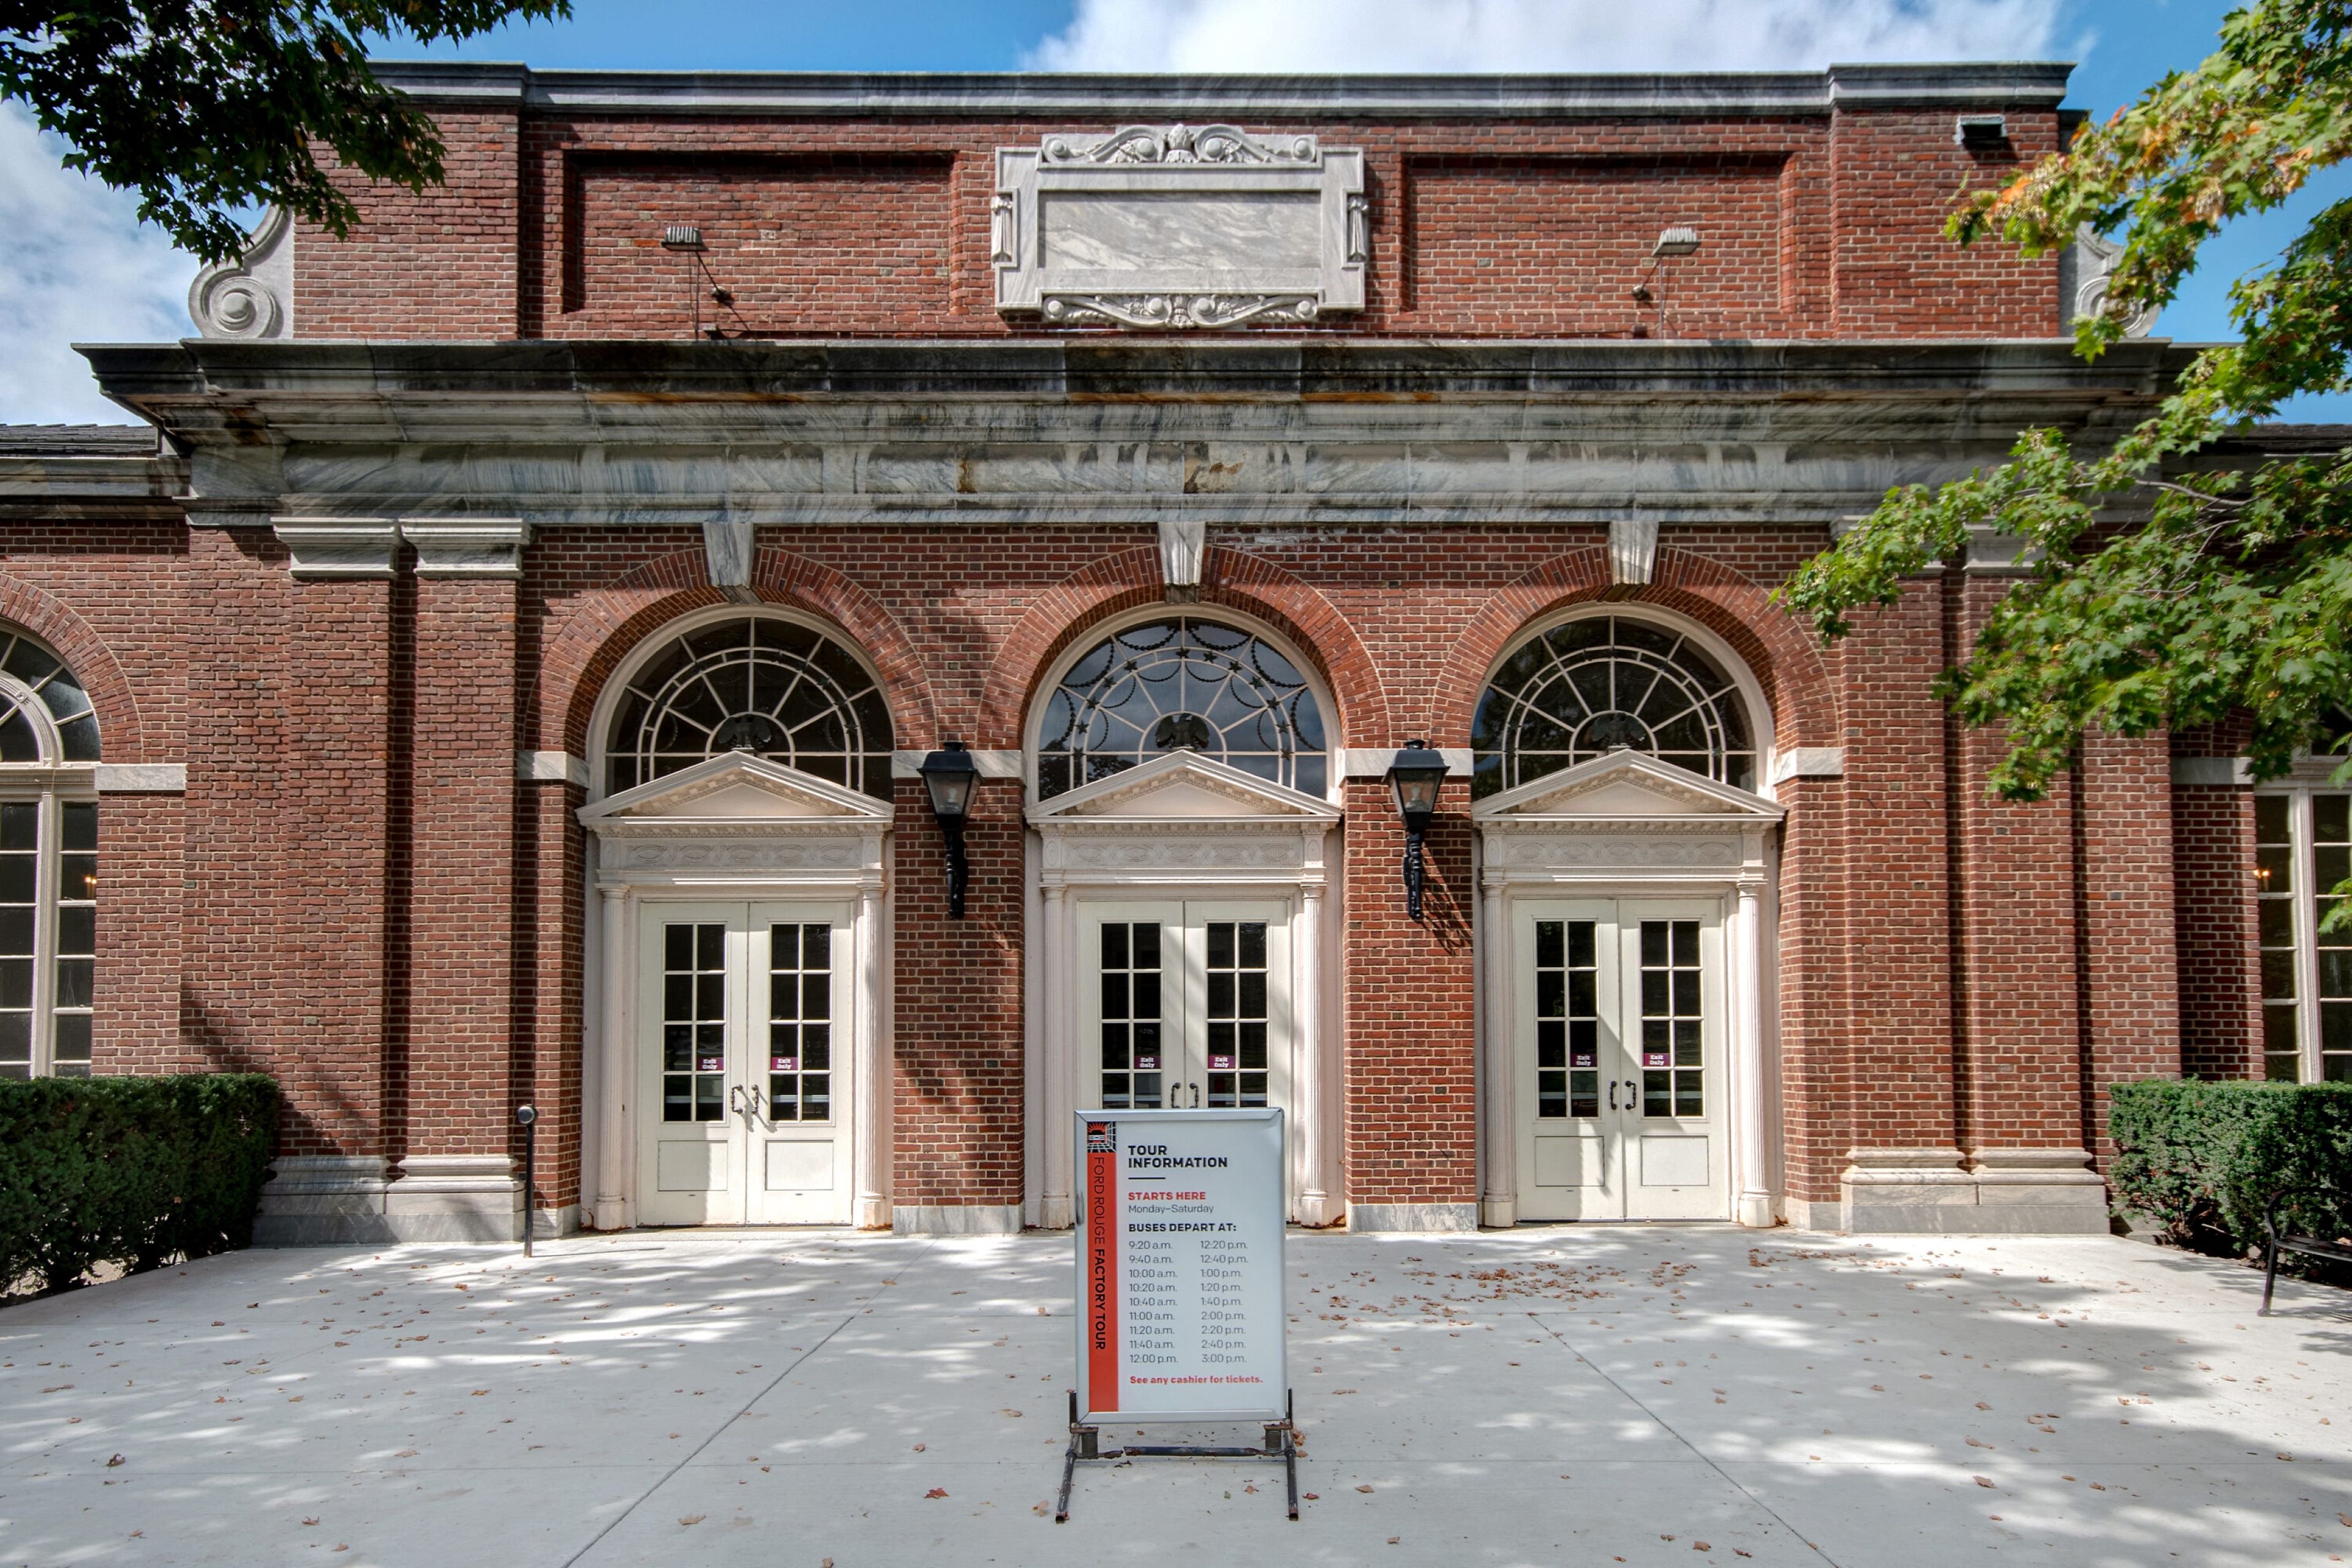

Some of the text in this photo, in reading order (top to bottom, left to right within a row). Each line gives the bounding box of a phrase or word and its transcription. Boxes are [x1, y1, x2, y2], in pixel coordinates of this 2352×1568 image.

[1128, 1145, 1167, 1155] TOUR
[1128, 1157, 1228, 1168] INFORMATION
[1128, 1192, 1206, 1200] STARTS HERE
[1128, 1223, 1237, 1232] BUSES DEPART AT:
[1129, 1241, 1150, 1250] 9:20
[1200, 1240, 1248, 1251] 12:20 p.m.
[1094, 1157, 1106, 1350] FORD ROUGE FACTORY TOUR
[1129, 1255, 1151, 1264] 9:40
[1200, 1255, 1248, 1265] 12:40 p.m.
[1129, 1269, 1155, 1278] 10:00
[1200, 1269, 1219, 1278] 1:00
[1129, 1283, 1155, 1292] 10:20
[1129, 1297, 1155, 1306] 10:40
[1200, 1297, 1220, 1306] 1:40
[1129, 1311, 1152, 1320] 11:00
[1201, 1311, 1223, 1320] 2:00
[1129, 1326, 1152, 1335] 11:20
[1201, 1325, 1223, 1334] 2:20
[1129, 1340, 1152, 1349] 11:40
[1201, 1340, 1223, 1348] 2:40
[1130, 1354, 1156, 1363] 12:00
[1202, 1354, 1224, 1363] 3:00
[1170, 1376, 1207, 1384] cashier
[1226, 1375, 1263, 1384] tickets.
